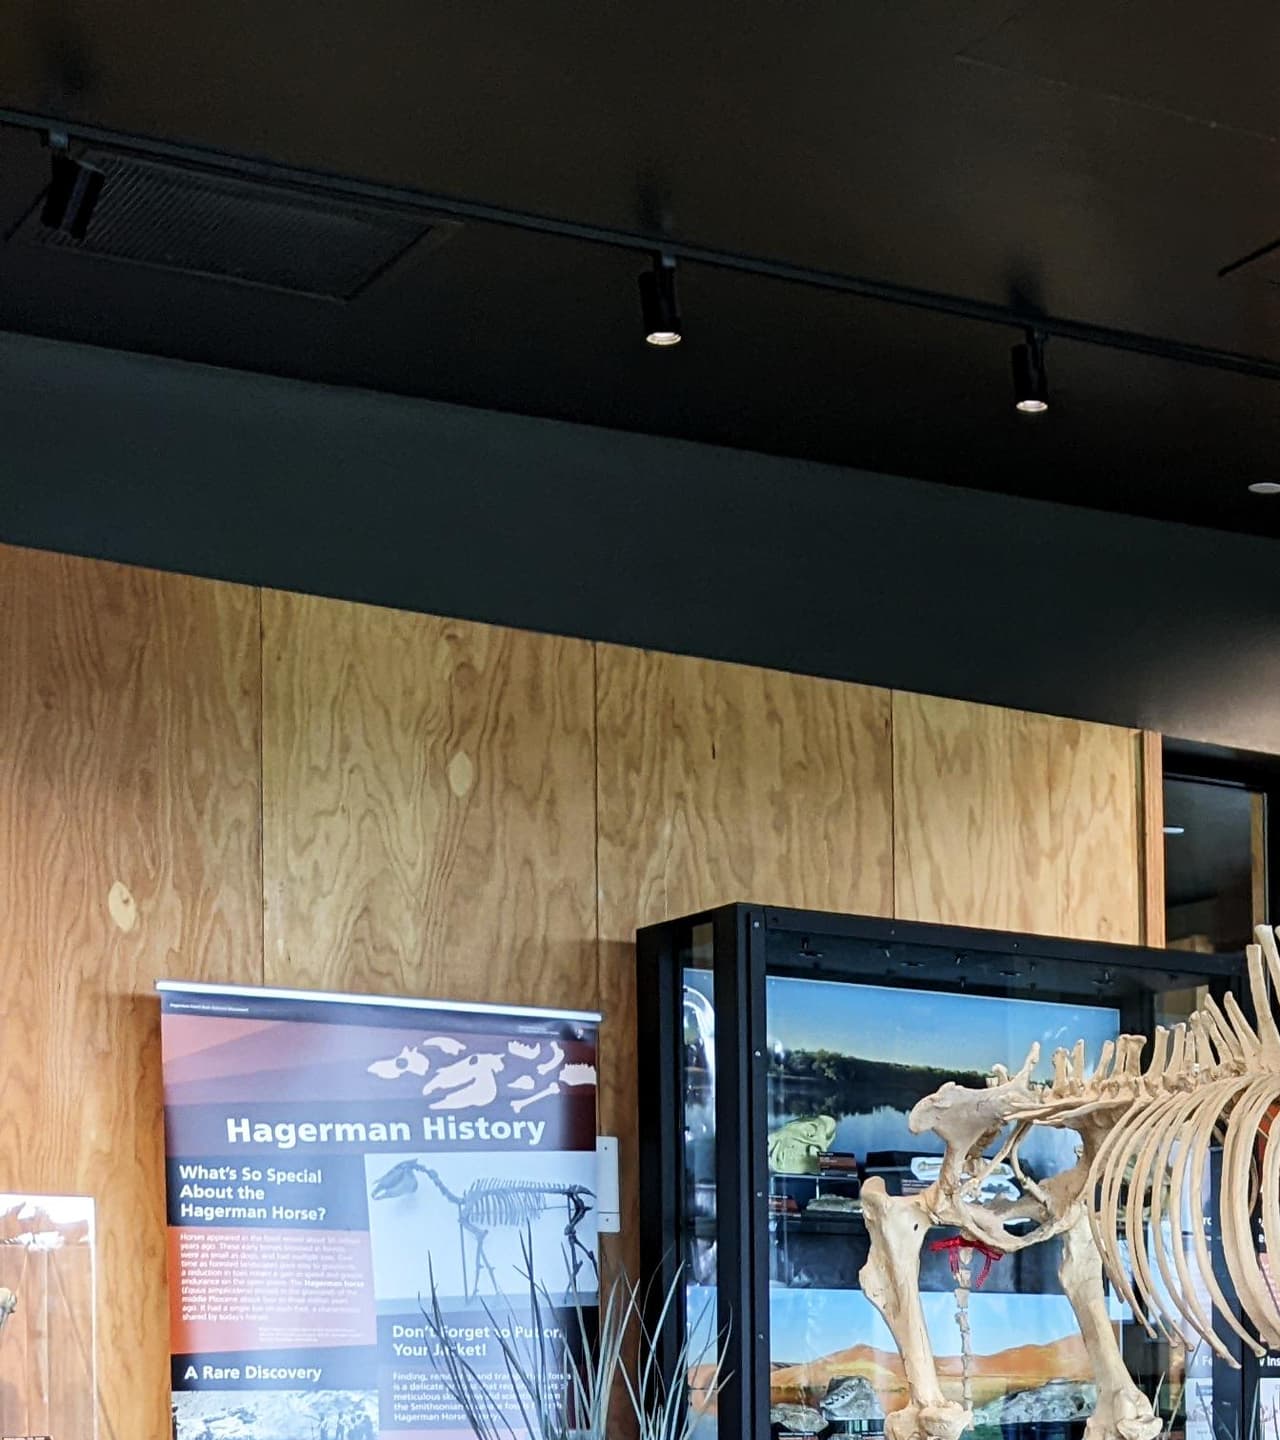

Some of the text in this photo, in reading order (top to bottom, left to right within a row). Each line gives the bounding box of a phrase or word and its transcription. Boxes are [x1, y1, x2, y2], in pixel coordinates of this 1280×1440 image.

[227, 1116, 545, 1148] Hagerman History
[180, 1166, 322, 1187] What's So Special
[180, 1184, 264, 1201] About the
[181, 1204, 325, 1222] Hagerman Horse?
[393, 1325, 436, 1338] Don't
[393, 1342, 486, 1356] Your Jaket!
[185, 1365, 322, 1384] A Rare Discovery
[394, 1413, 439, 1423] Hagerman
